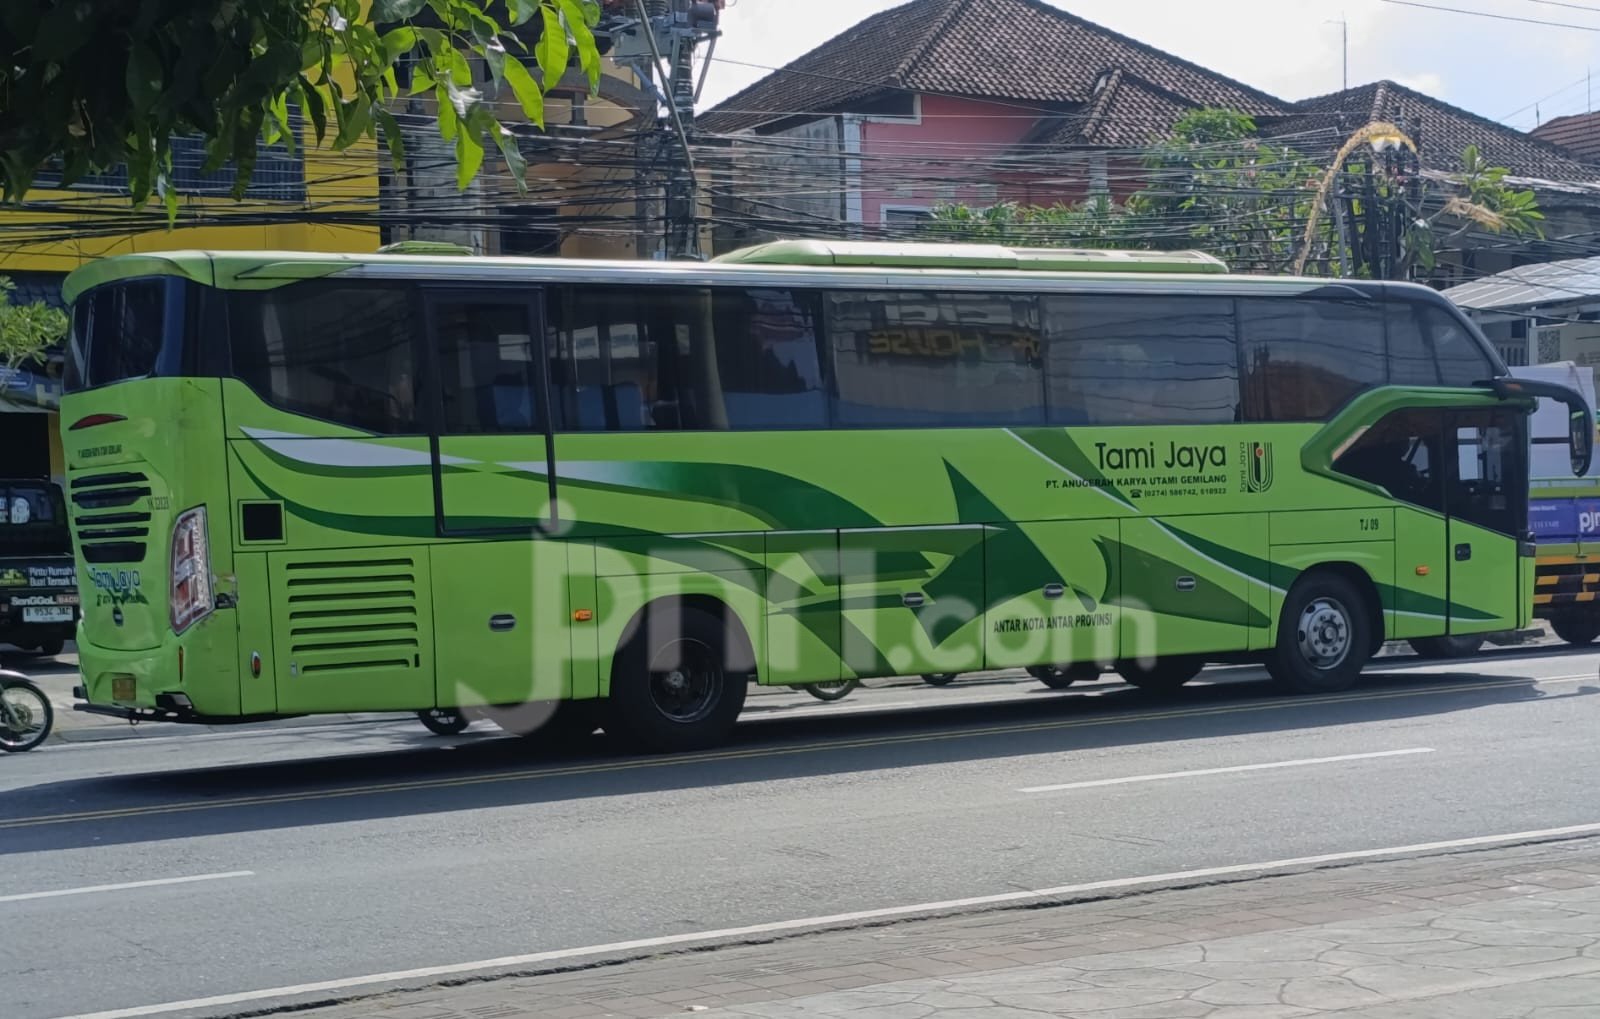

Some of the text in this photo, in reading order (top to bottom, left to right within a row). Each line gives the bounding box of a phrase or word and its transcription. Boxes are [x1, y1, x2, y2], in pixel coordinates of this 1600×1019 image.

[1095, 441, 1227, 473] Tami Jaya
[1045, 474, 1227, 489] PT. ANUGERAH KARYA UTAMI GEMILANG
[1359, 518, 1379, 531] TJ 09
[994, 613, 1113, 633] ANTAR KOTA ANTAR PROVINSI
